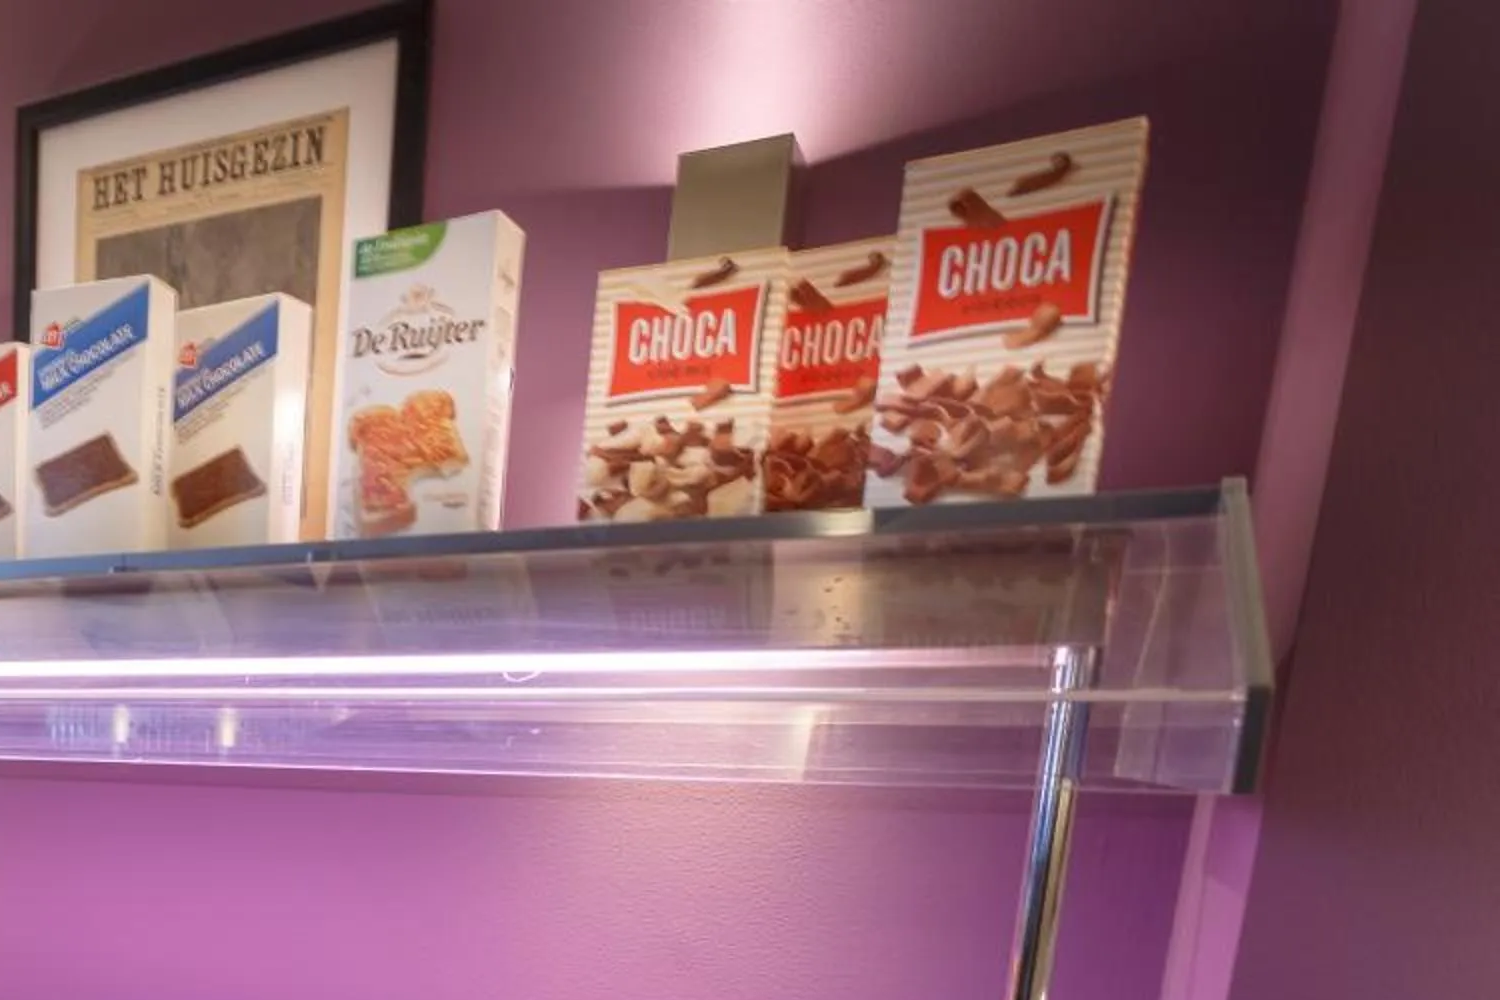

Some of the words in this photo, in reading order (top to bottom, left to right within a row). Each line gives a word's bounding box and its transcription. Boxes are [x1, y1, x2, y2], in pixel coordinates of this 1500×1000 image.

[92, 166, 148, 212] HET
[157, 126, 328, 196] HUISGEZIN
[937, 227, 1072, 300] CHOCA
[351, 326, 387, 358] De
[628, 307, 738, 366] CHOCA
[781, 313, 887, 371] CHOCA
